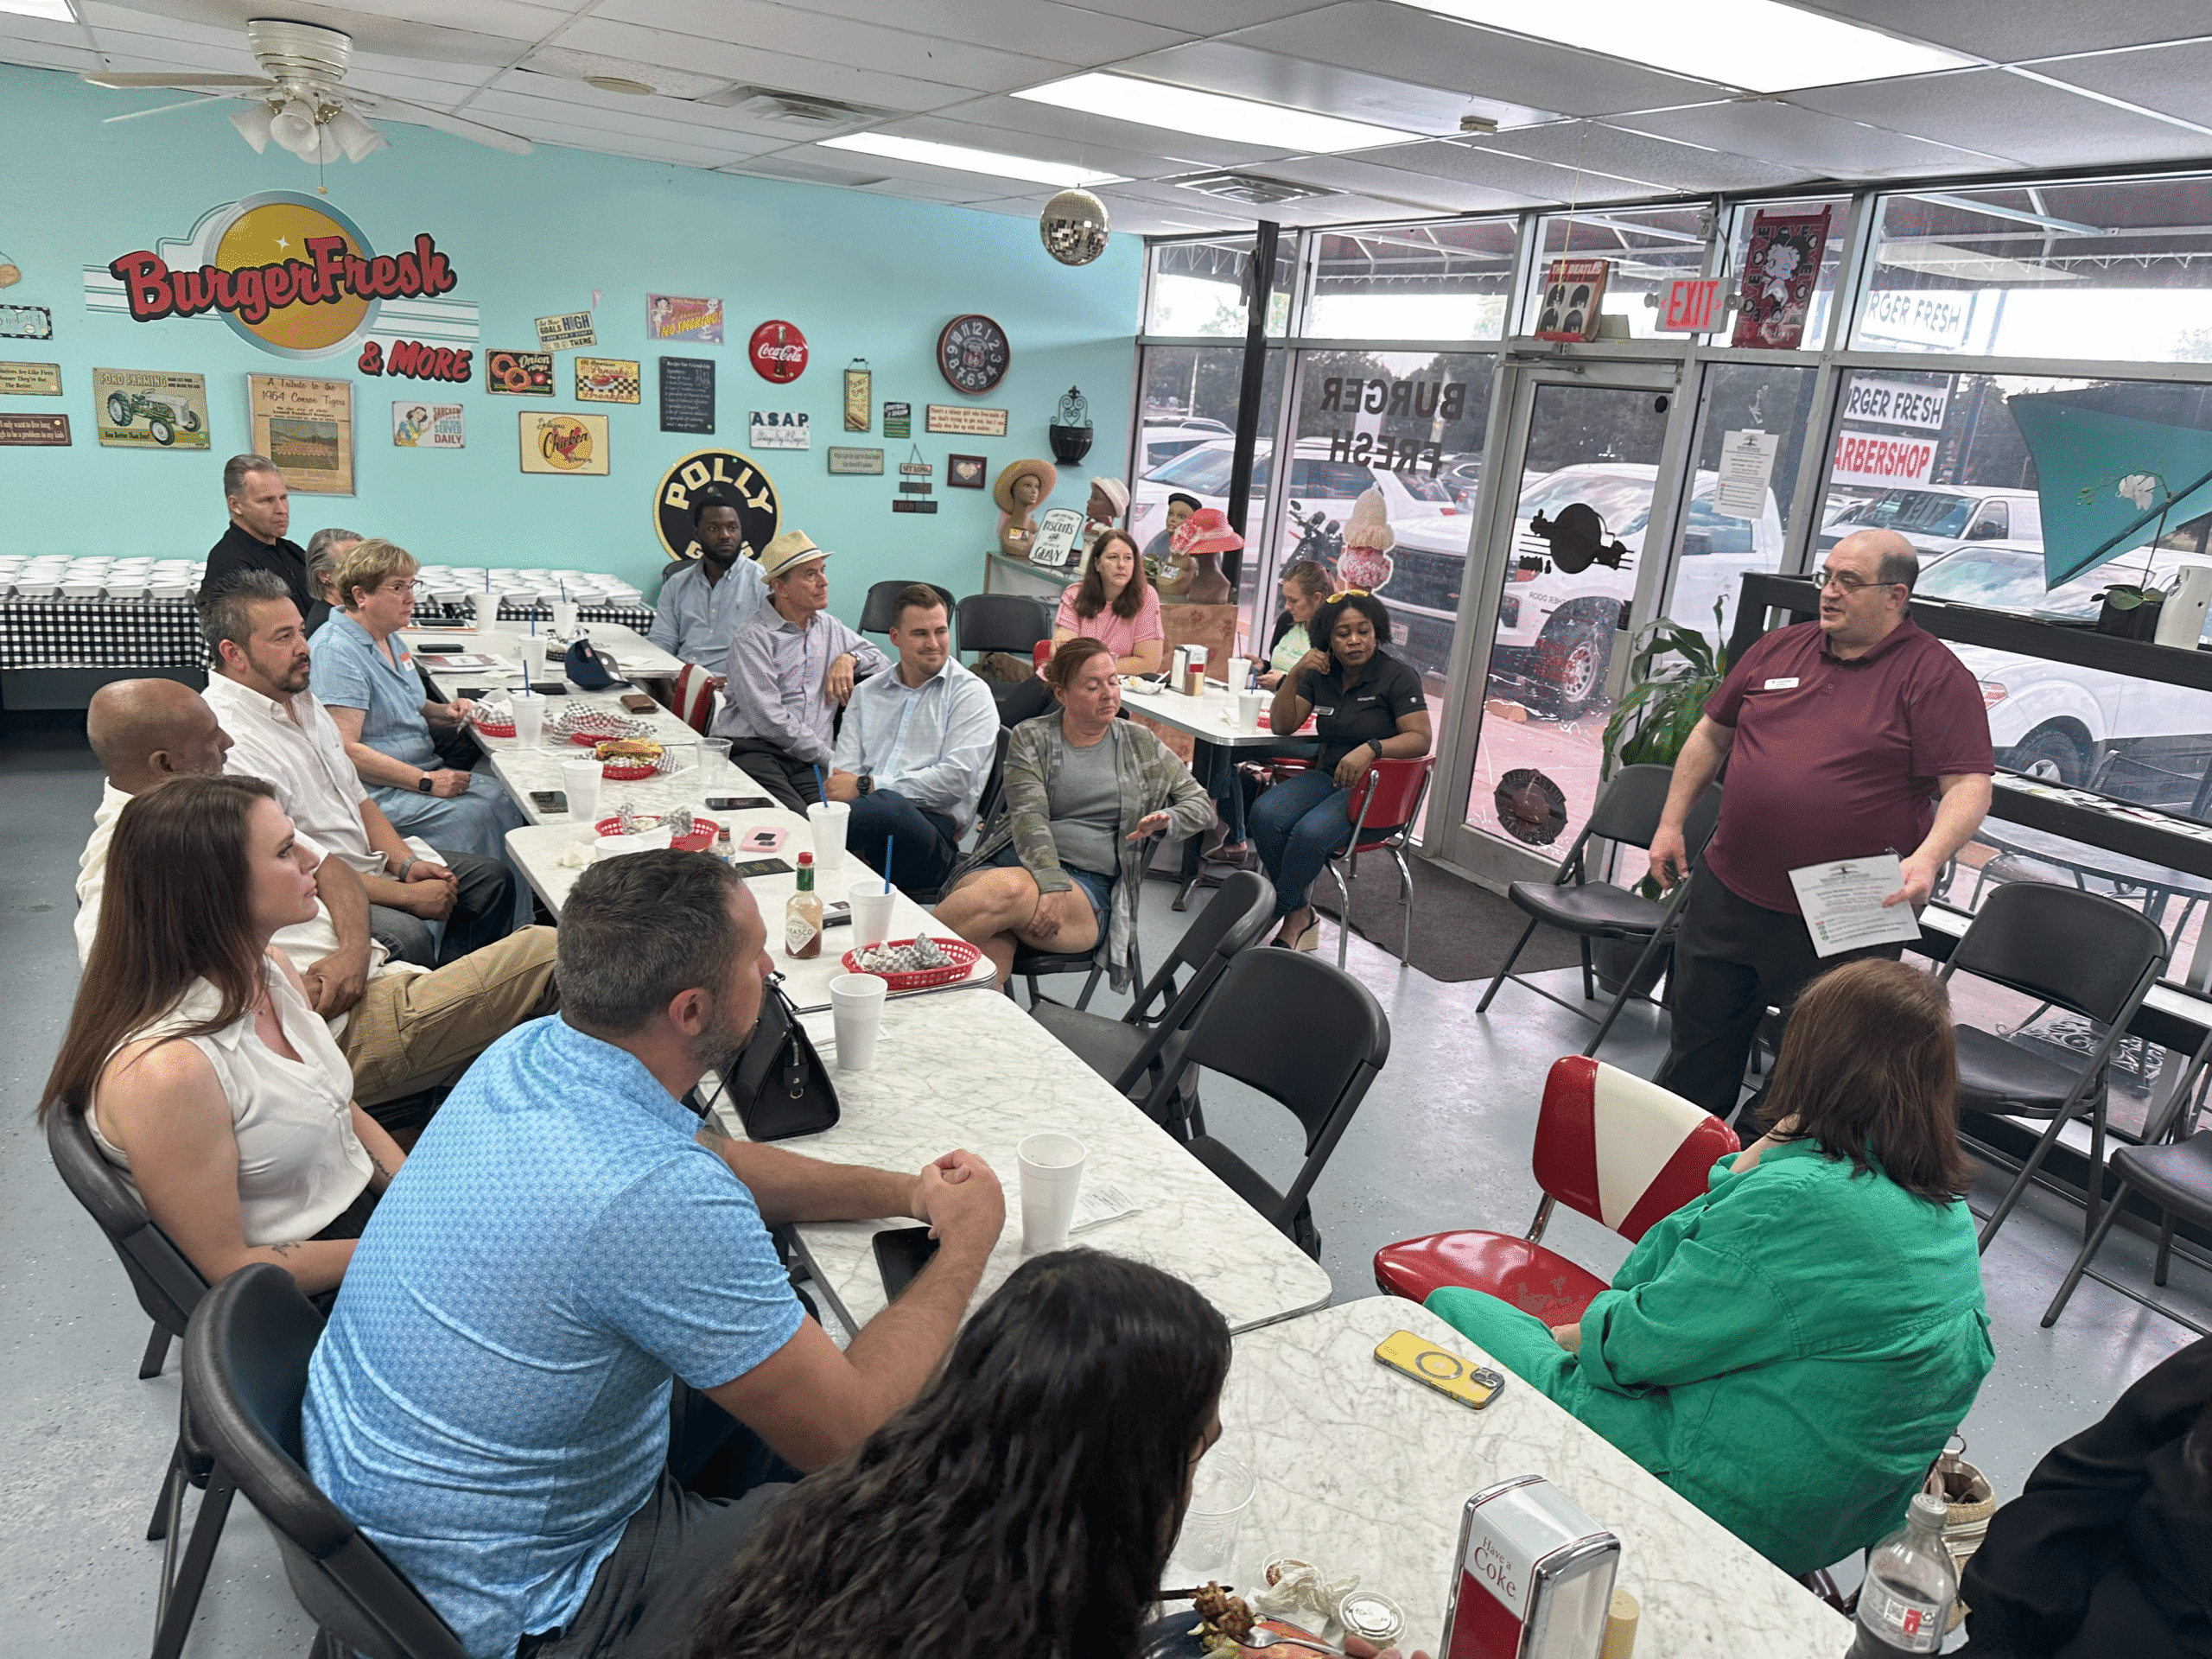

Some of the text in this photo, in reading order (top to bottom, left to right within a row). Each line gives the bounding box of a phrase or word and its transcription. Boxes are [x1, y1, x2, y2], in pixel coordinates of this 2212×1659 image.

[110, 233, 457, 324] BurgerFresh
[1665, 281, 1719, 327] EXIT
[563, 315, 590, 331] HIGH
[1913, 299, 1961, 334] FRESH
[540, 325, 563, 334] GOALS
[961, 323, 970, 337] 11
[972, 321, 983, 336] 12
[984, 328, 992, 340] 1
[950, 330, 963, 345] 10
[988, 339, 1001, 351] 2
[946, 345, 958, 355] 9
[359, 340, 474, 383] & MORE
[518, 354, 551, 369] Onion
[949, 358, 960, 370] 8
[990, 353, 1002, 363] 3
[527, 364, 549, 372] rings
[128, 375, 167, 388] FARMING
[967, 372, 976, 386] 6
[977, 372, 988, 385] 5
[262, 391, 285, 402] 1964
[1848, 385, 1944, 424] RGER FRESH
[434, 434, 462, 444] DAILY
[543, 429, 588, 459] Chicken
[664, 457, 773, 514] POLLY
[1034, 547, 1065, 562] GRAVY
[1482, 1536, 1511, 1571] Have a
[1474, 1546, 1516, 1598] Coke
